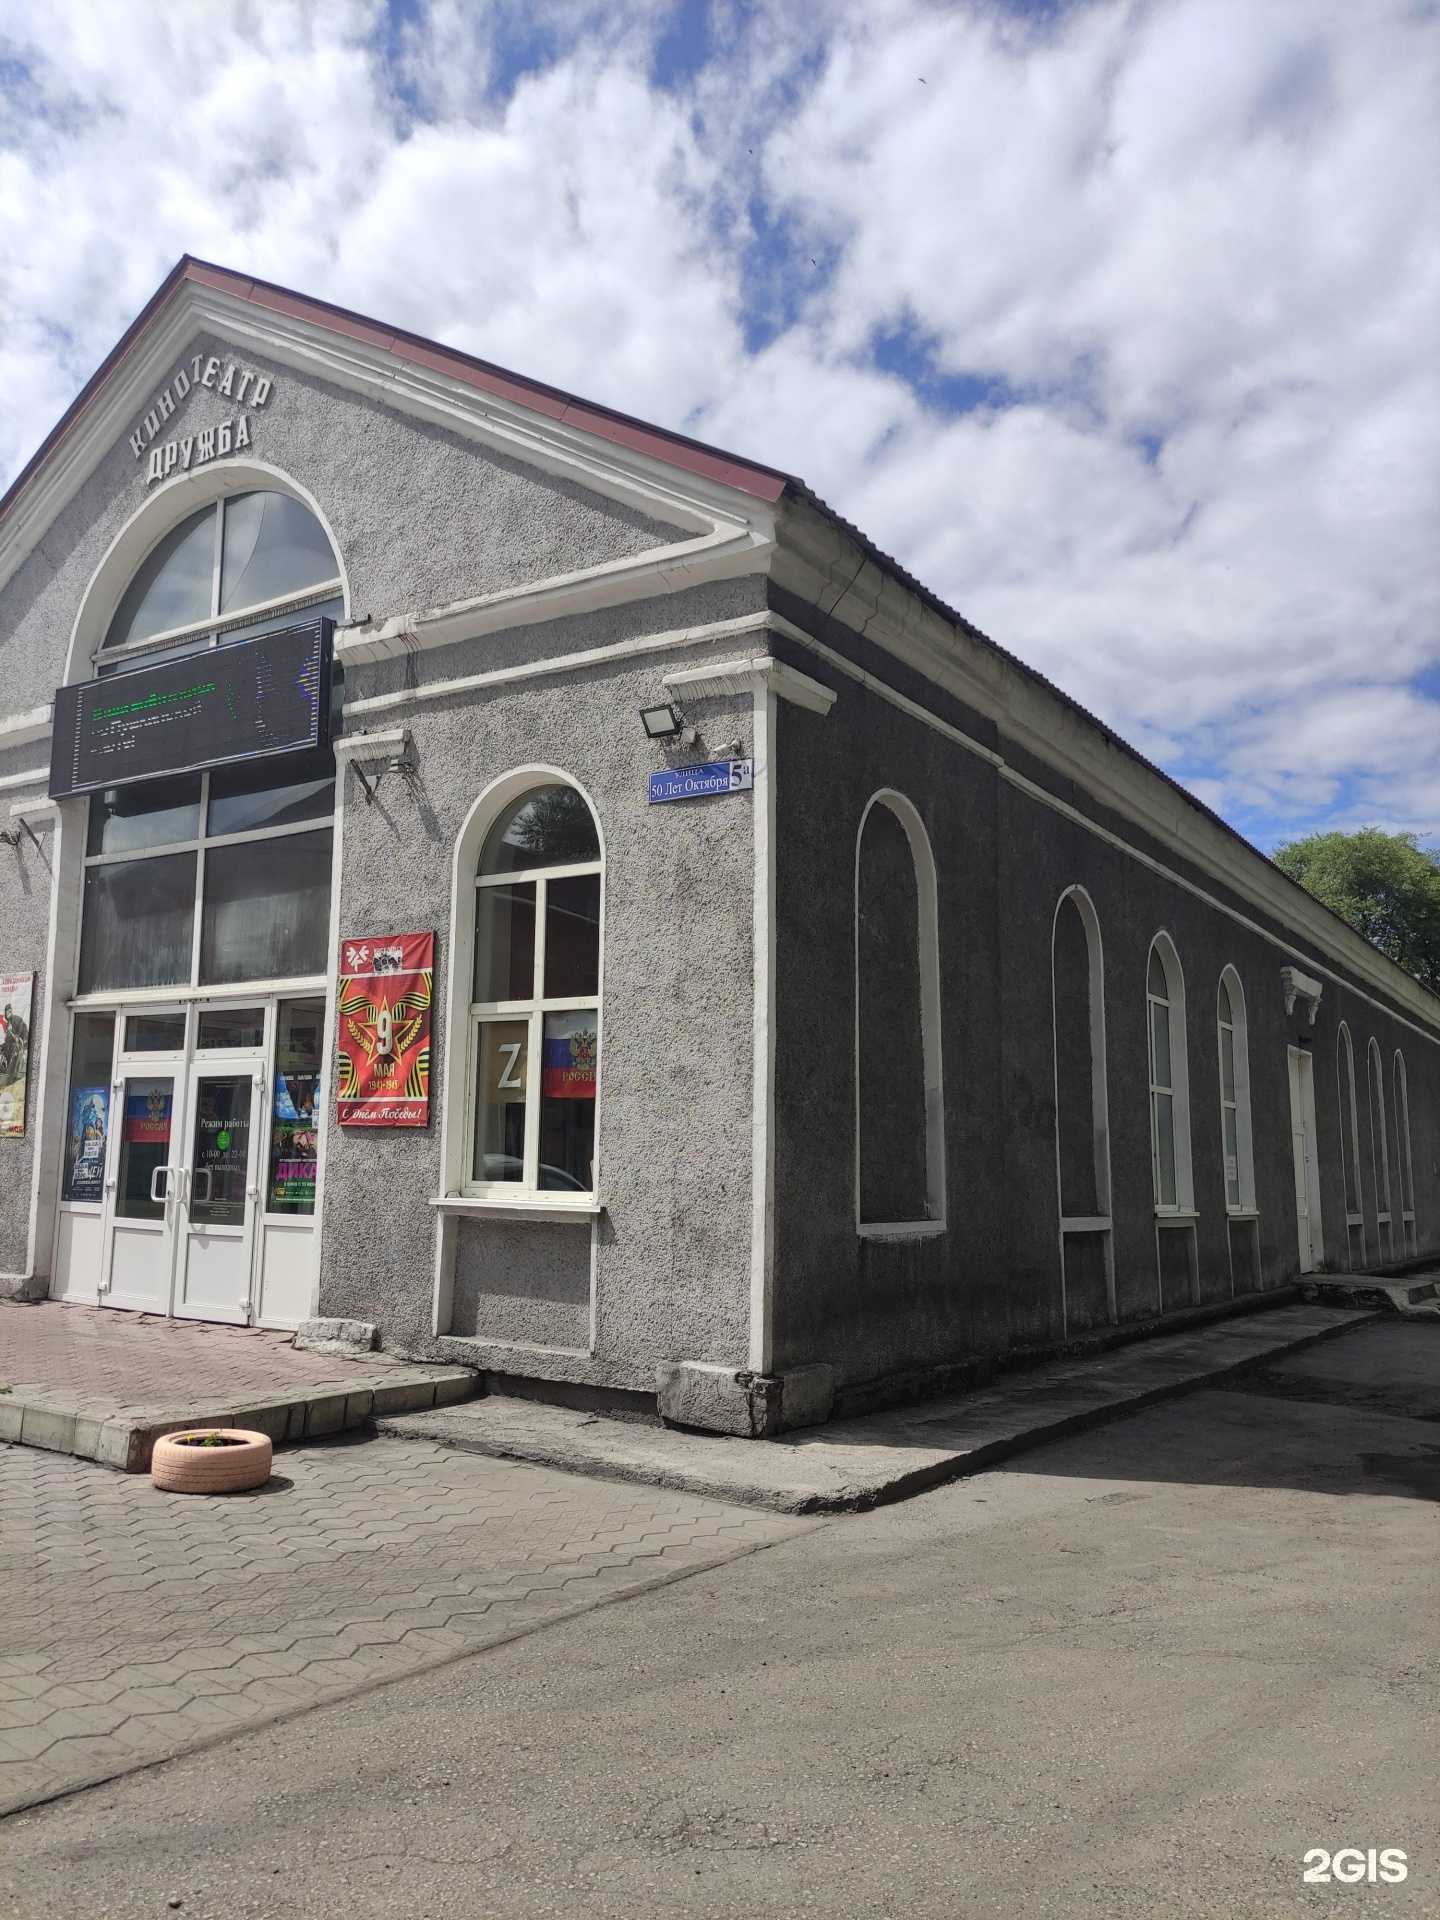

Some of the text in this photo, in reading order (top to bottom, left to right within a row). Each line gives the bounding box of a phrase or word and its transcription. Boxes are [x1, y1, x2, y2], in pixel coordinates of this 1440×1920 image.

[128, 354, 272, 460] КИНОТЕАТР
[146, 414, 251, 486] ДРУЖБА
[651, 775, 729, 798] 50 Лет Октября
[376, 1010, 393, 1055] 9
[373, 1062, 396, 1078] МАЯ
[498, 1043, 522, 1089] Z
[562, 1071, 597, 1083] РОССИ
